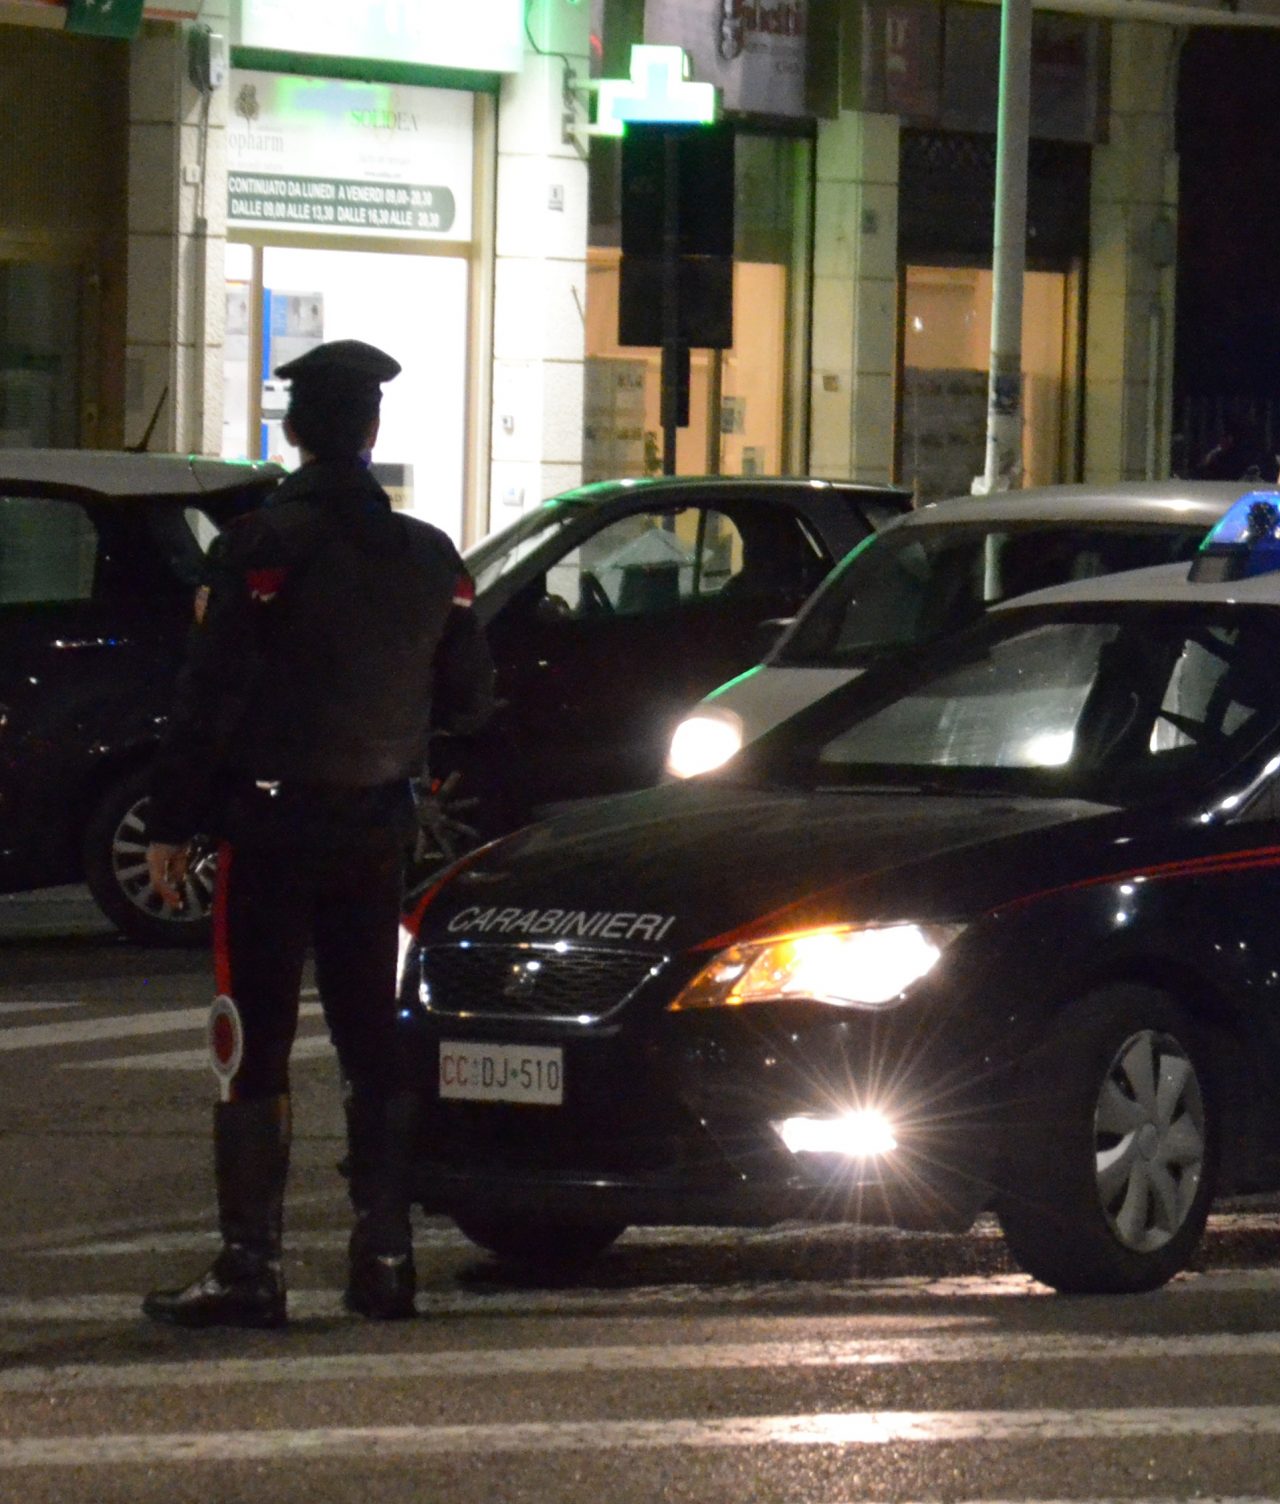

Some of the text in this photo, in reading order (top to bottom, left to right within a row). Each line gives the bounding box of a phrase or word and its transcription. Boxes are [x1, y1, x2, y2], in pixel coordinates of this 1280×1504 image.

[228, 177, 286, 197] CONTINUATO
[288, 181, 301, 196] DA
[303, 182, 335, 199] LUNEDI
[338, 185, 346, 200] A
[346, 185, 384, 203] VENERDI
[231, 199, 262, 215] DALLE
[287, 203, 311, 219] ALLE
[337, 206, 366, 222] DALLE
[389, 210, 413, 225] ALLE
[447, 905, 676, 941] CARABINIERI
[520, 1058, 560, 1091] 510
